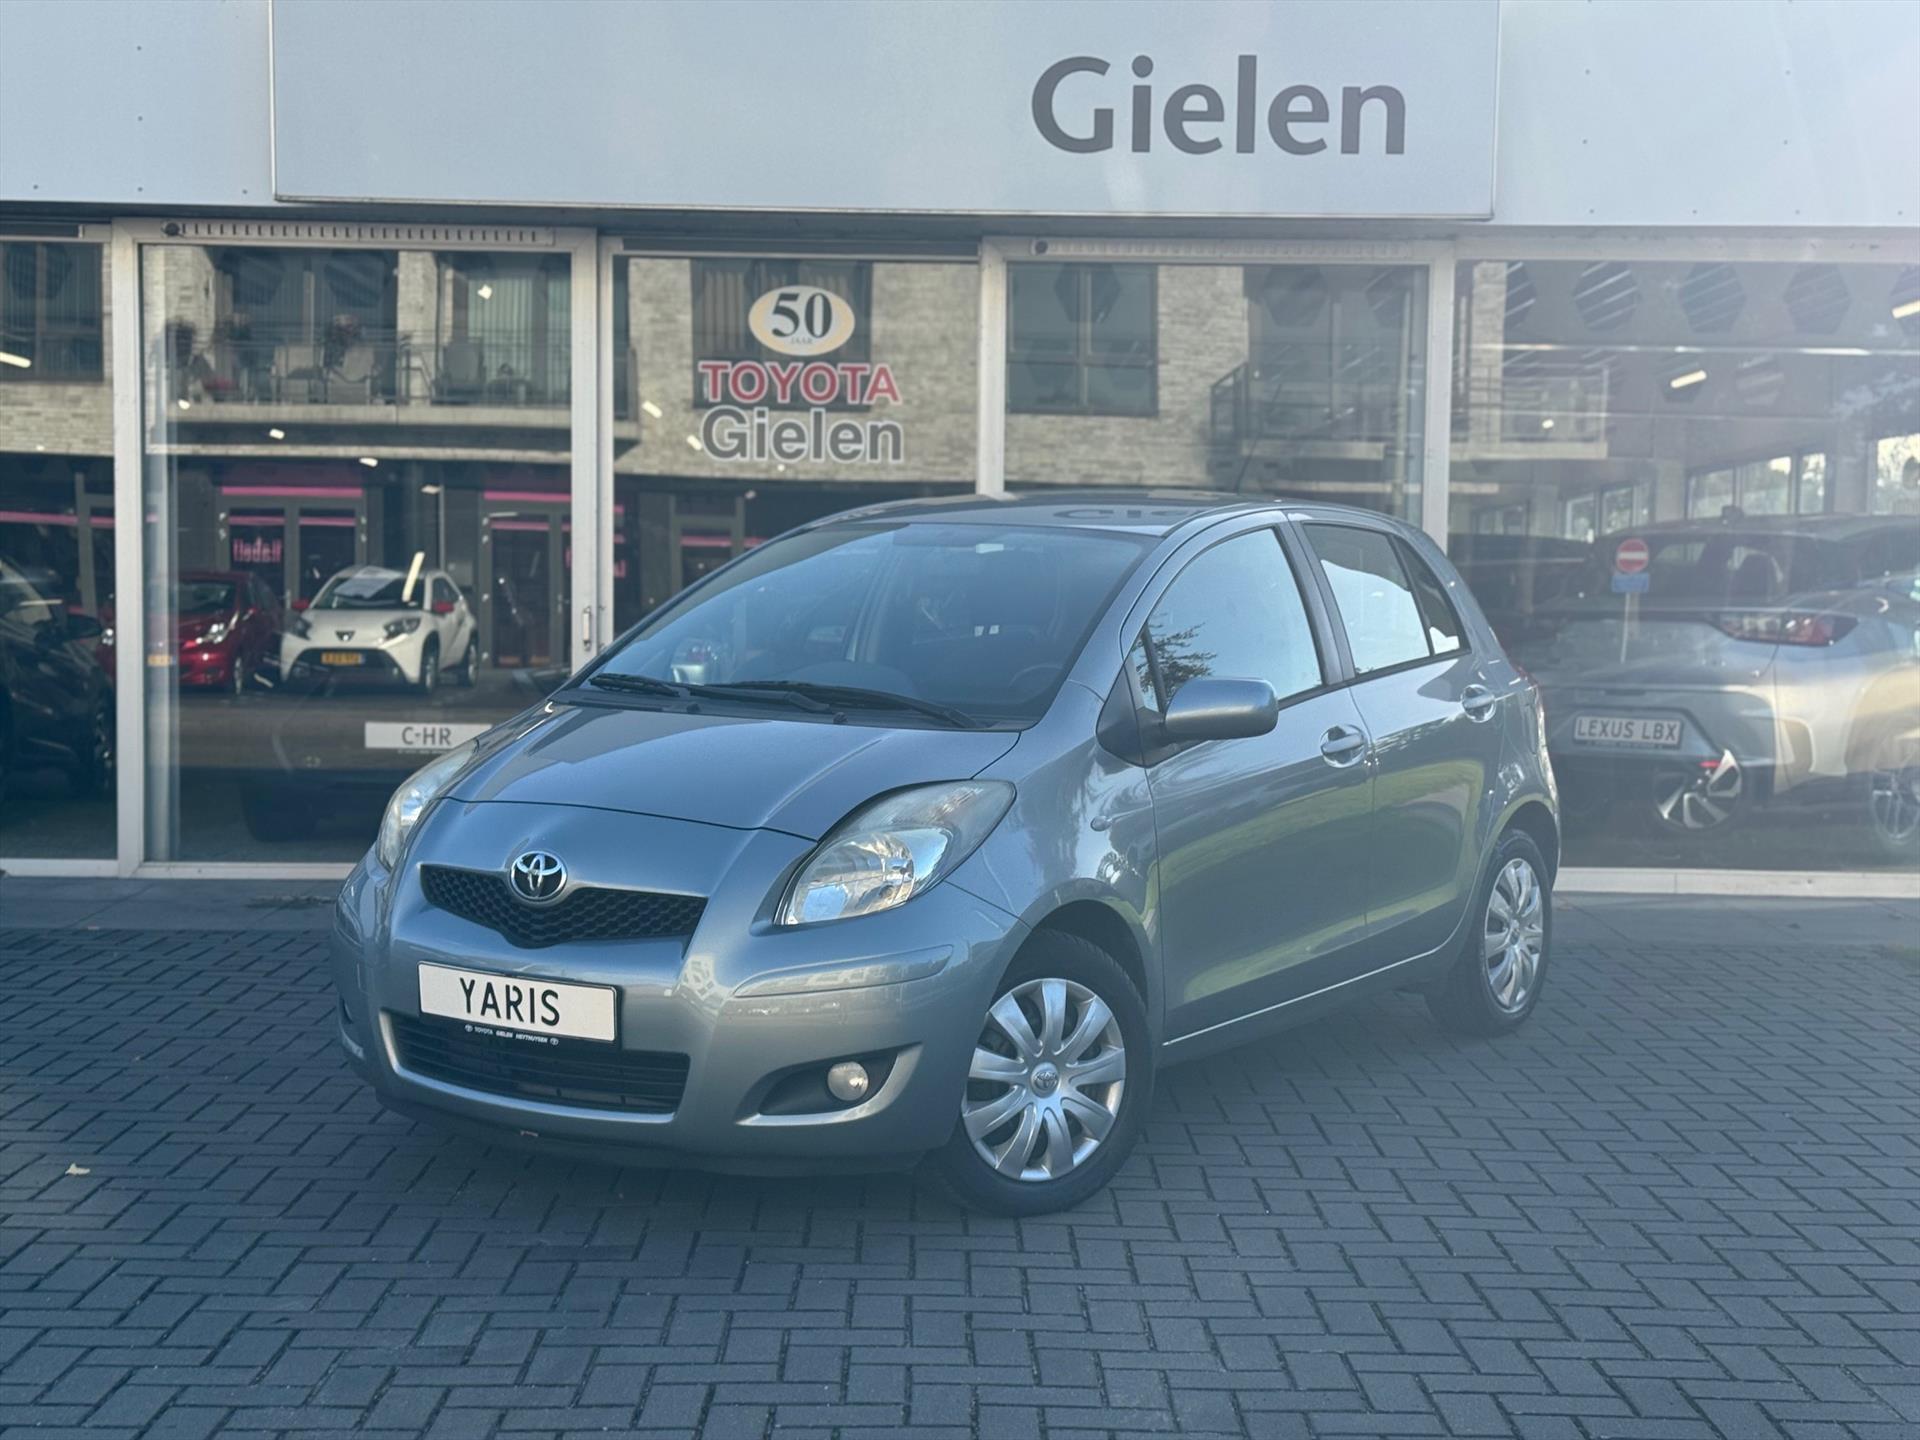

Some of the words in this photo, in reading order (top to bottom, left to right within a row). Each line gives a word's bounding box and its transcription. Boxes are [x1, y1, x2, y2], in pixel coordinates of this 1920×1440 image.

[1031, 54, 1406, 155] Gielen
[771, 292, 833, 339] 50
[698, 361, 902, 404] TOYOTA
[702, 405, 904, 463] Gielen
[401, 726, 452, 746] C-HR
[1576, 718, 1635, 739] LEXUS
[1642, 721, 1678, 742] LBX
[459, 977, 560, 1027] YARIS
[474, 1026, 494, 1035] TOYOTA
